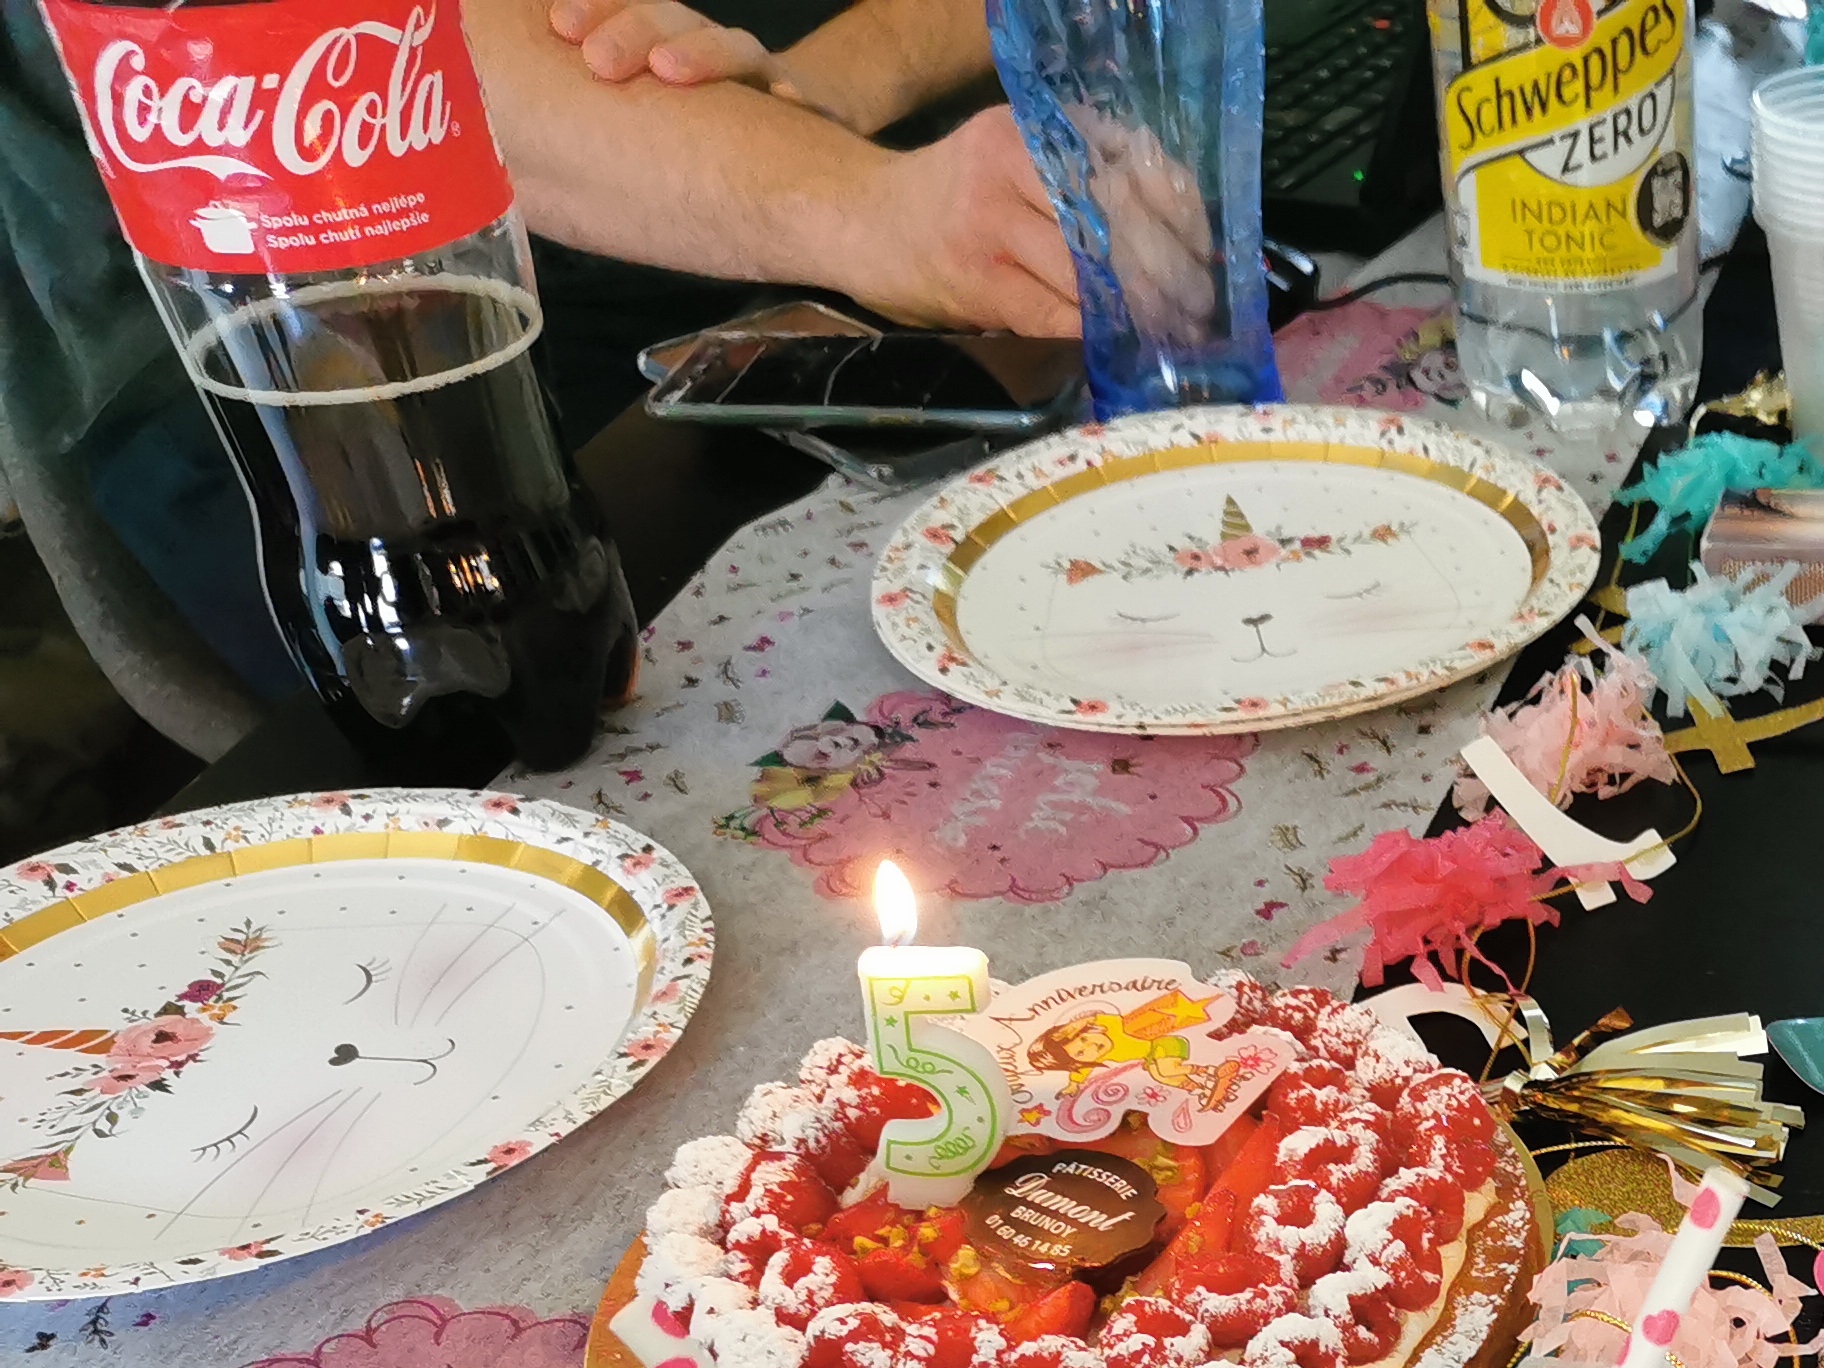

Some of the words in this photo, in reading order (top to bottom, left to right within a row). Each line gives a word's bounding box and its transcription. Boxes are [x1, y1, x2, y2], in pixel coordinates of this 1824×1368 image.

[95, 3, 451, 181] Coca-Cola
[1456, 0, 1677, 151] Schweppes
[1560, 91, 1658, 176] ZERO
[1511, 196, 1628, 226] INDIAN
[1524, 228, 1616, 252] TONIC
[860, 950, 1006, 1204] 5
[1052, 1161, 1139, 1200] PÂTISSERIE
[1010, 1206, 1078, 1238] BRUNOY
